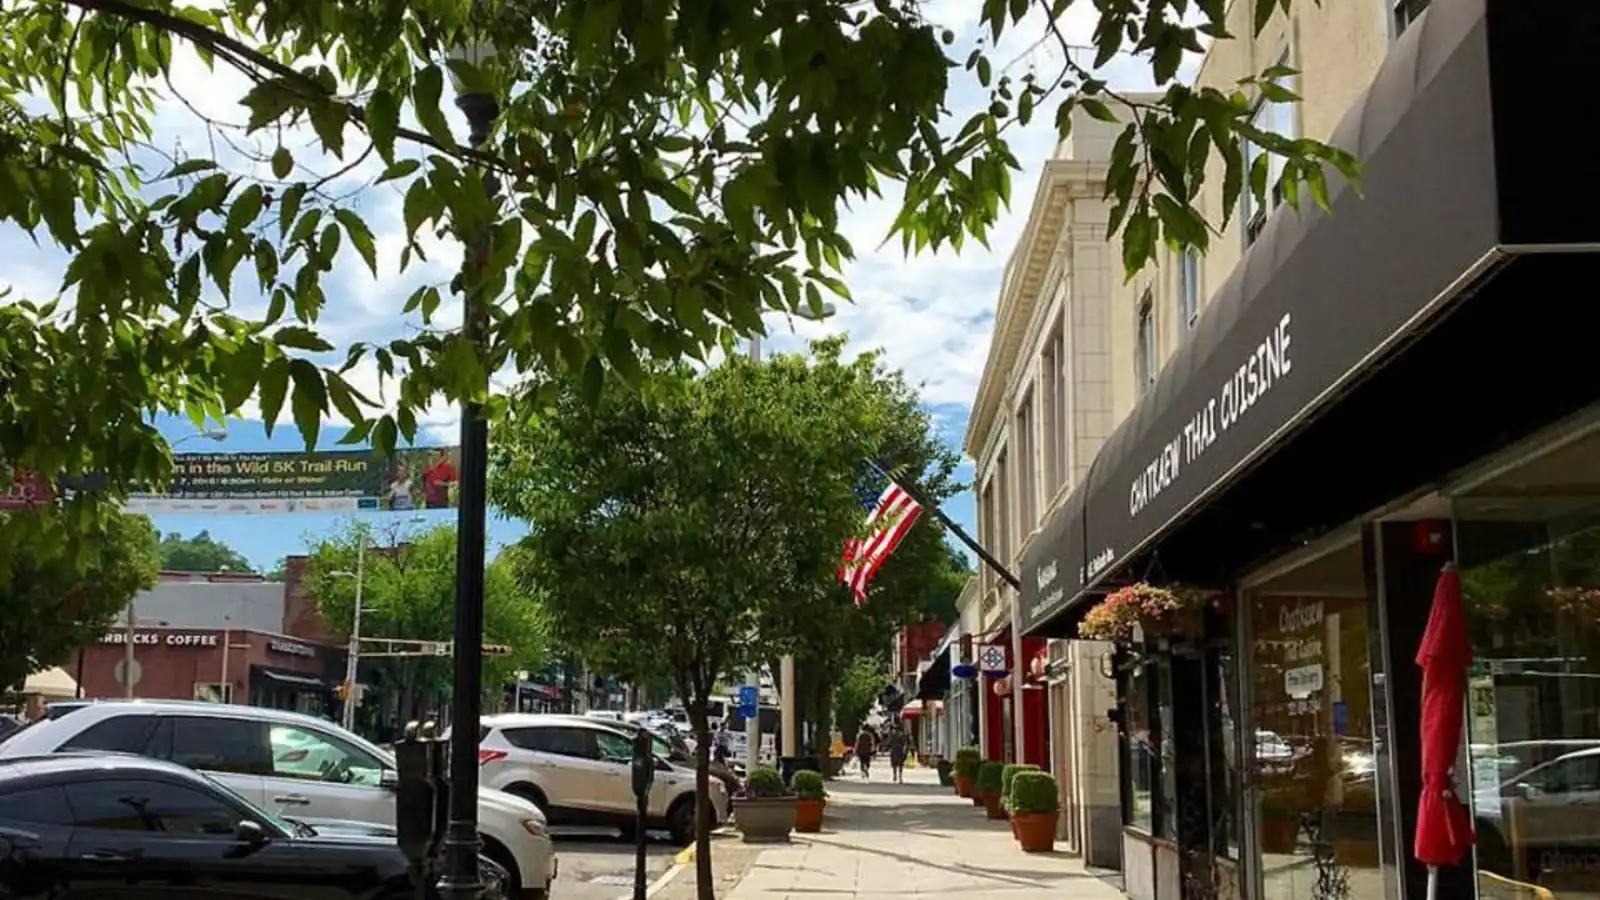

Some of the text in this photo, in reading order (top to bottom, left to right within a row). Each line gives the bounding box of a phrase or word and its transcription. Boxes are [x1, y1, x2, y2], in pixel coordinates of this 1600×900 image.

[1184, 398, 1216, 465] THAI
[1220, 312, 1292, 430] CUISINE
[189, 461, 203, 474] in
[206, 460, 233, 474] the
[235, 460, 270, 475] Wild
[272, 460, 296, 474] 5K
[300, 459, 331, 473] Trail
[334, 458, 369, 473] Run
[166, 634, 217, 646] COFFEE
